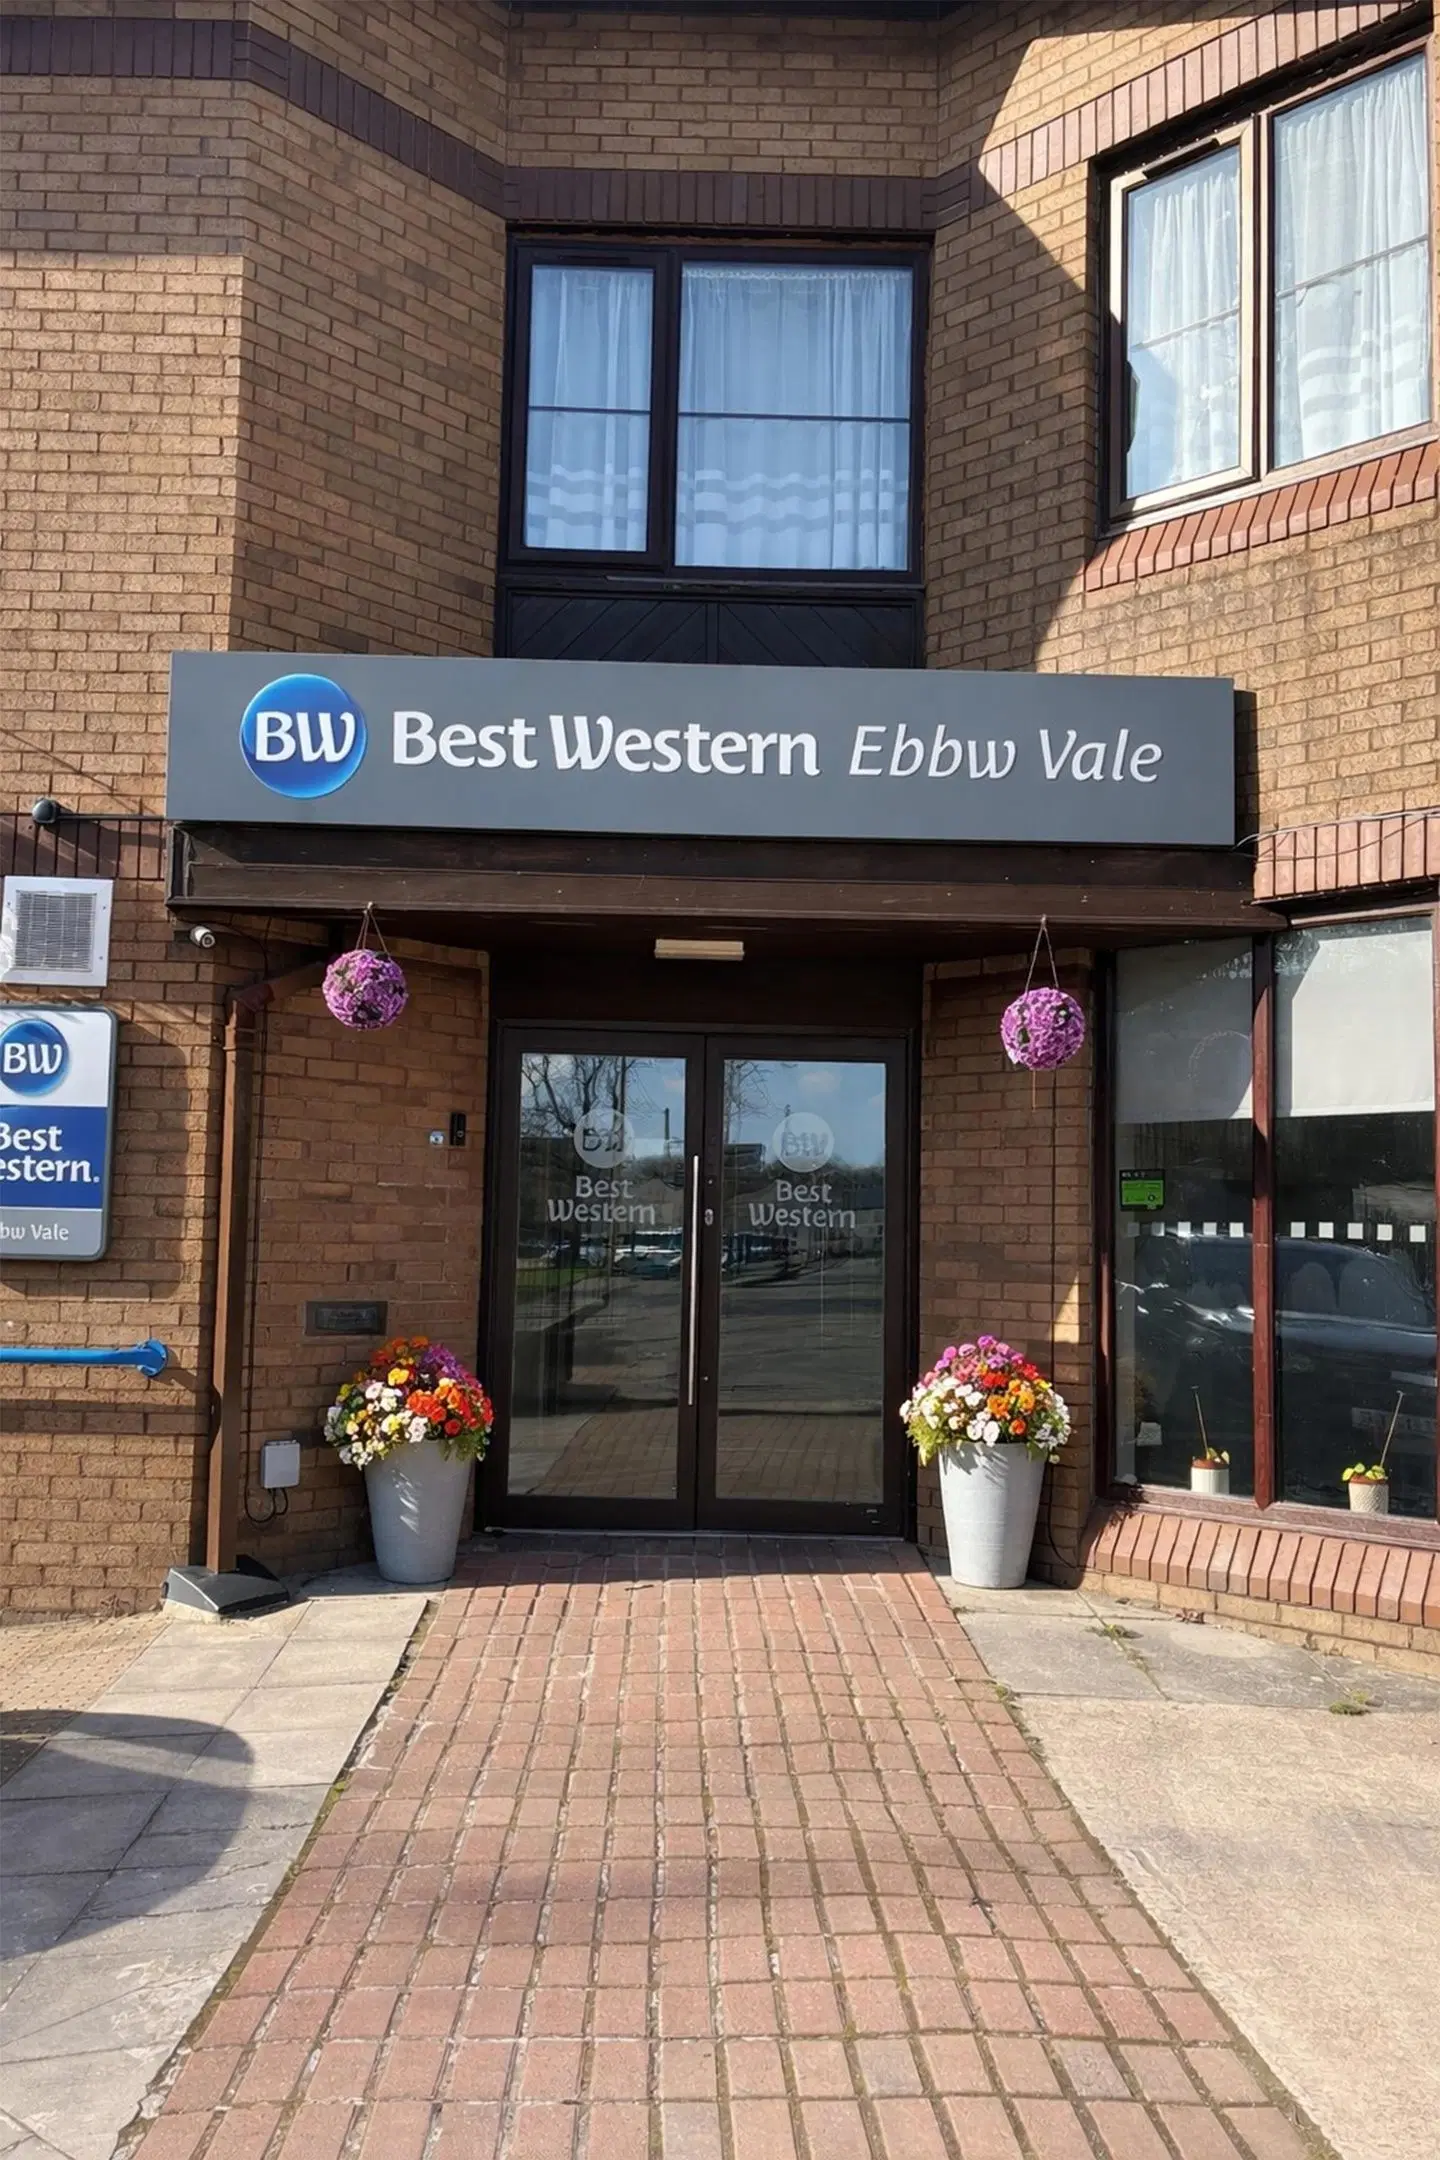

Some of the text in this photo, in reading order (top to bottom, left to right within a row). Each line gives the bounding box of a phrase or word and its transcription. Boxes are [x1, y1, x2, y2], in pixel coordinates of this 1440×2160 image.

[255, 711, 1163, 782] BW Best Western Ebbw Vale
[4, 1043, 63, 1074] BW
[576, 1175, 634, 1199] Best
[776, 1179, 832, 1203] Best
[548, 1199, 655, 1225] Western
[749, 1203, 855, 1229] Western
[30, 1224, 69, 1241] Vale
